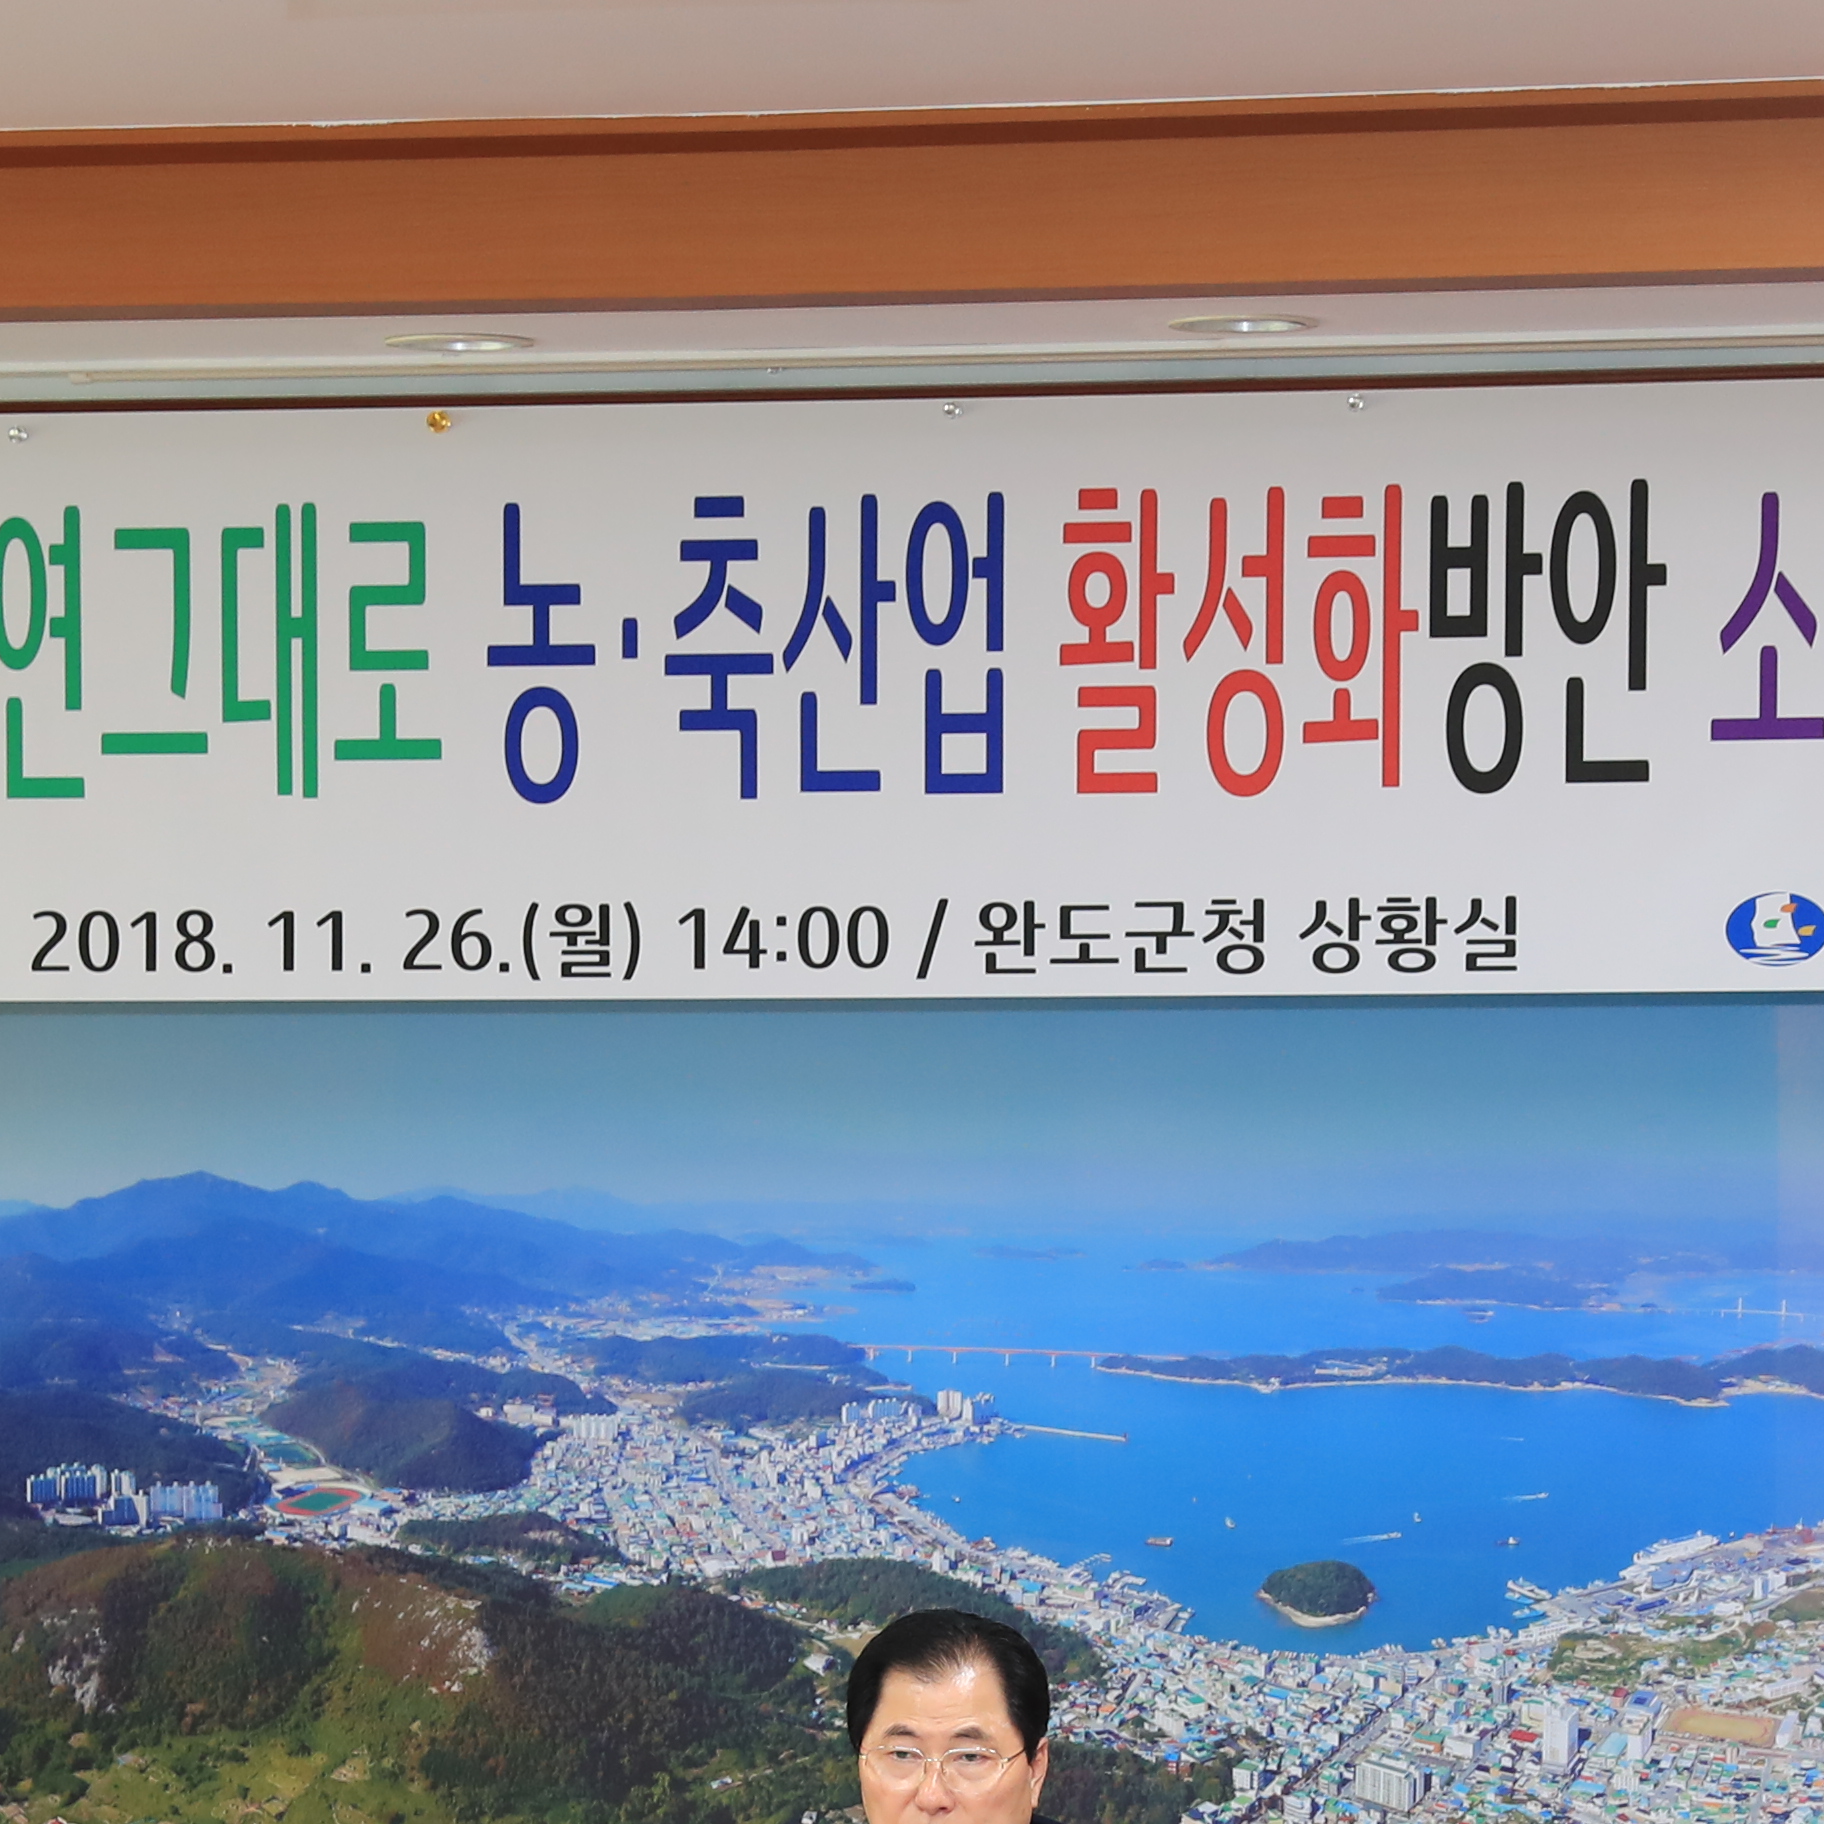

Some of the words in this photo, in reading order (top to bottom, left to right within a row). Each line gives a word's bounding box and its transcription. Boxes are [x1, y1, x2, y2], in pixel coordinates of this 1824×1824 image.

[486, 491, 1005, 805] 농·축산업
[1059, 478, 1668, 797] 활성화방안
[32, 909, 233, 974] 2018.
[267, 910, 371, 974] 11.
[678, 905, 889, 970] 14:00
[974, 898, 1265, 975] 완도군청
[1299, 895, 1518, 974] 상황실
